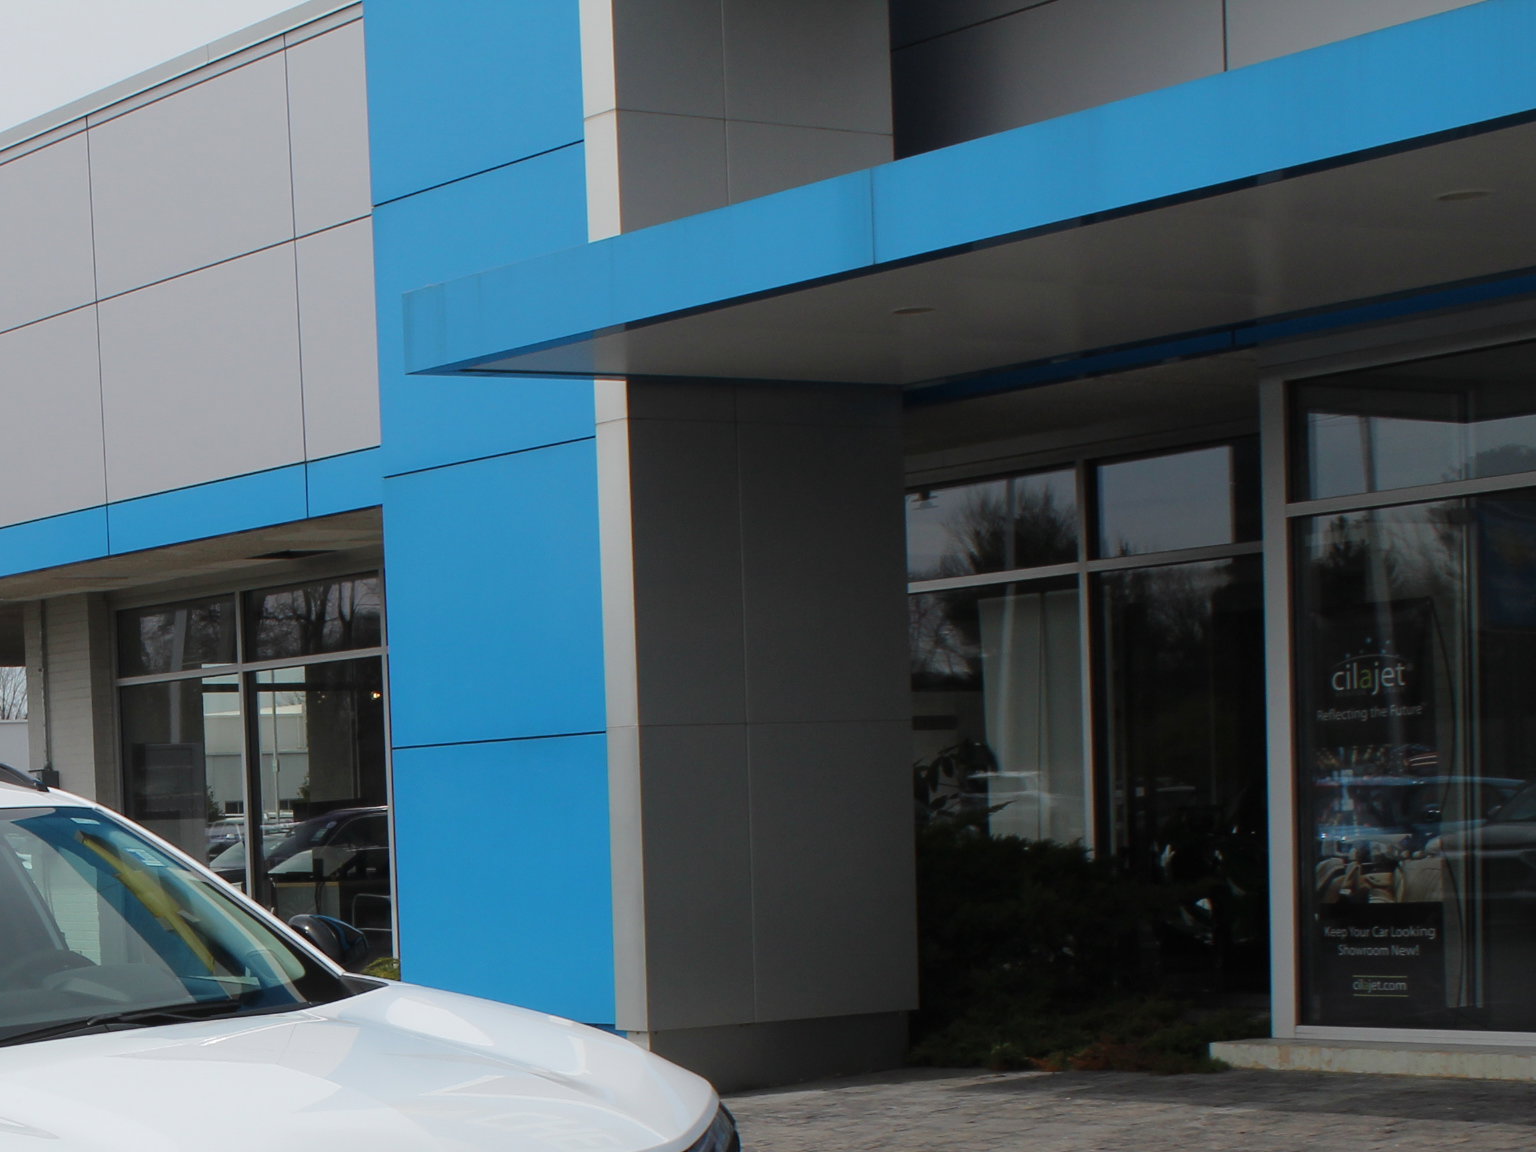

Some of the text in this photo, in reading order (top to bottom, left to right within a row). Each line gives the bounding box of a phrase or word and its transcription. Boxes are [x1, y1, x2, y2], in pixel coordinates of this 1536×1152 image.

[1331, 661, 1406, 695] cilajet
[1316, 708, 1368, 722] Reflecting
[1370, 706, 1388, 718] the
[1324, 926, 1437, 940] Keep Your Car Looking
[1337, 944, 1420, 956] Showroom New!
[1352, 979, 1408, 993] cilajet.com
